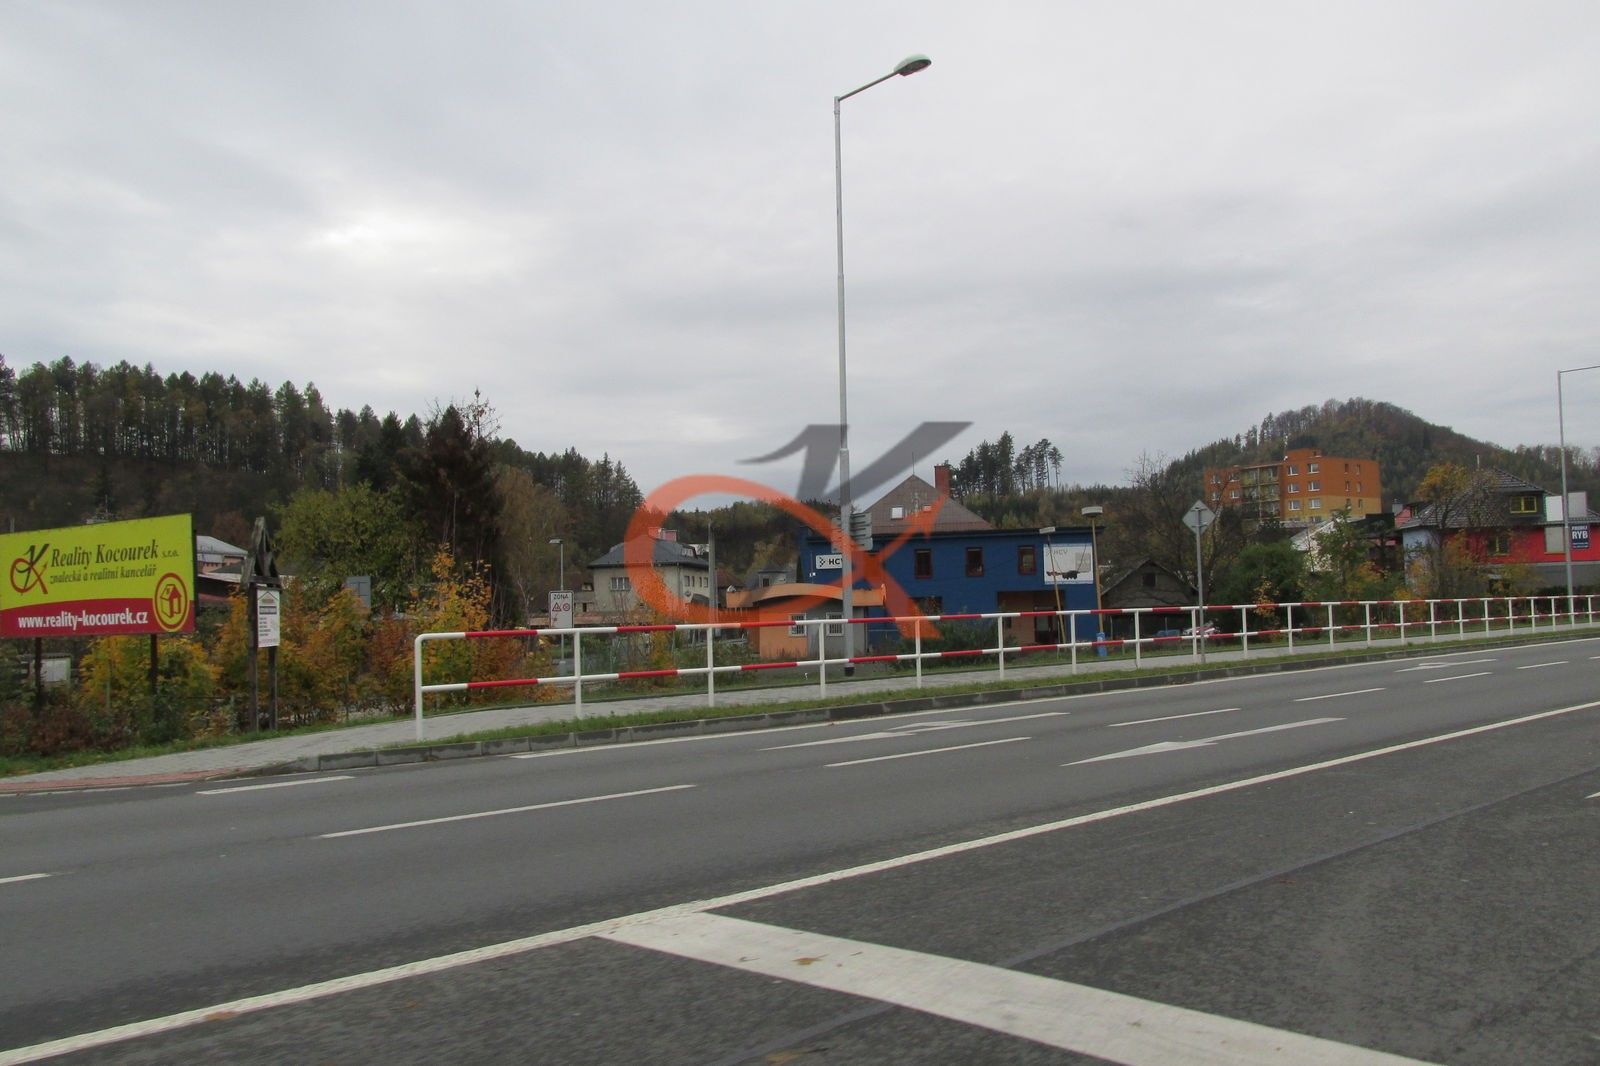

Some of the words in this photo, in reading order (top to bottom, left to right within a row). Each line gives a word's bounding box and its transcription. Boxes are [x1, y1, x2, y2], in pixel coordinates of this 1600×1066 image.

[1572, 530, 1589, 540] RYB
[51, 546, 92, 570] Reality
[96, 539, 158, 564] Kocourek
[18, 607, 149, 631] www.reality-kocourek.cz
